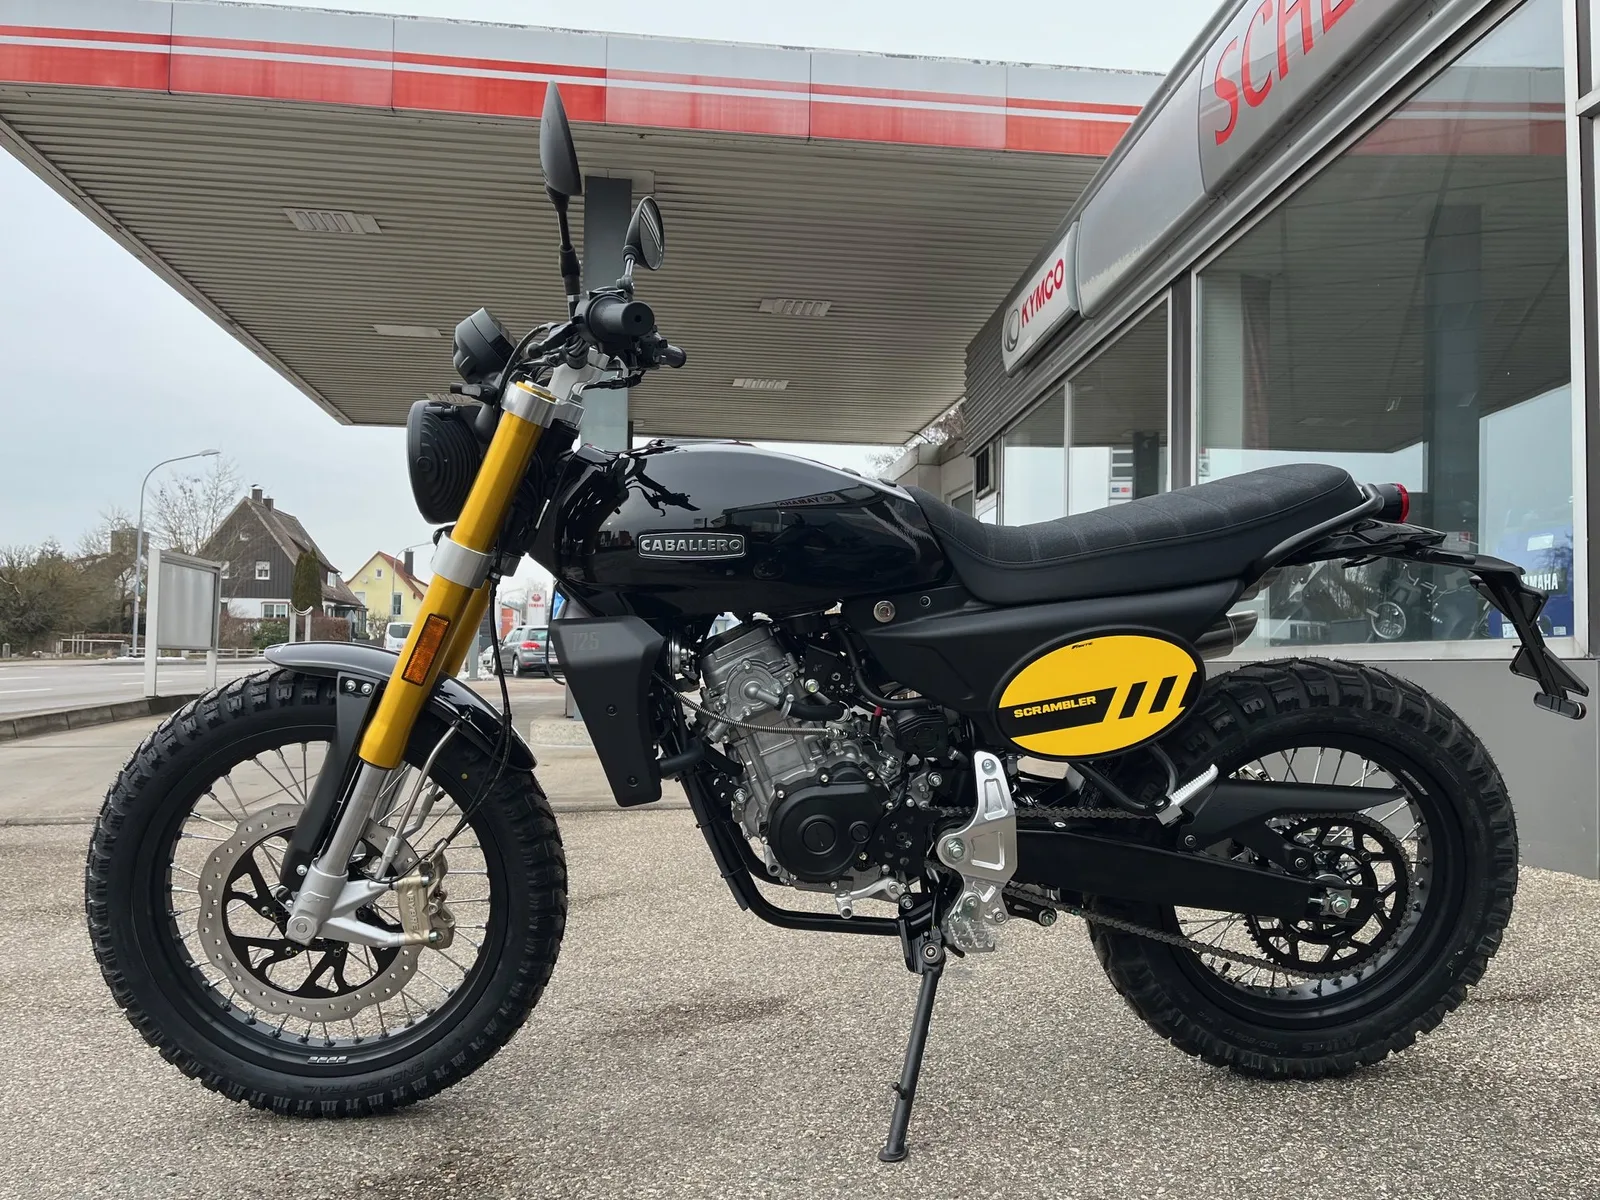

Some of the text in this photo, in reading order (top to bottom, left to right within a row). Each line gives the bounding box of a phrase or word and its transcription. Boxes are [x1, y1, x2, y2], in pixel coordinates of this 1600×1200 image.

[1021, 258, 1064, 328] KYMCO
[640, 539, 742, 552] CABALLERO
[1520, 573, 1559, 590] AMAHA
[1013, 696, 1097, 718] SCRAMBLER
